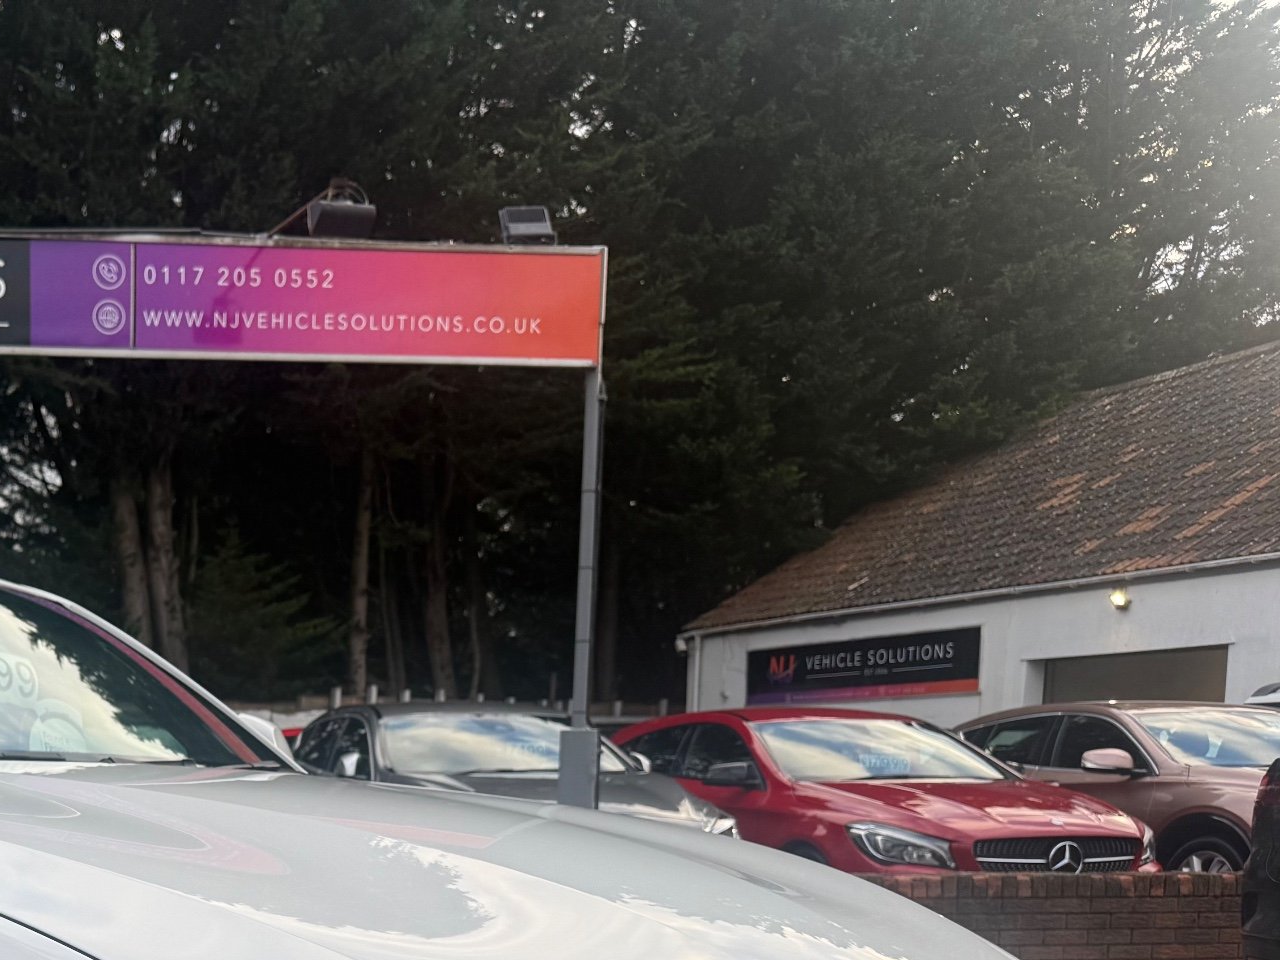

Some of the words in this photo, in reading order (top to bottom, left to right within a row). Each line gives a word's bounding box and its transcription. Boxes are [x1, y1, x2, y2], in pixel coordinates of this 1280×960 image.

[143, 265, 204, 286] 0117
[217, 267, 262, 288] 205
[274, 269, 335, 289] 0552
[142, 309, 542, 335] WWW.NJVEHICLESOLUTIONS.CO.UK
[806, 651, 862, 670] VEHICLE
[867, 642, 955, 666] SOLUTIONS
